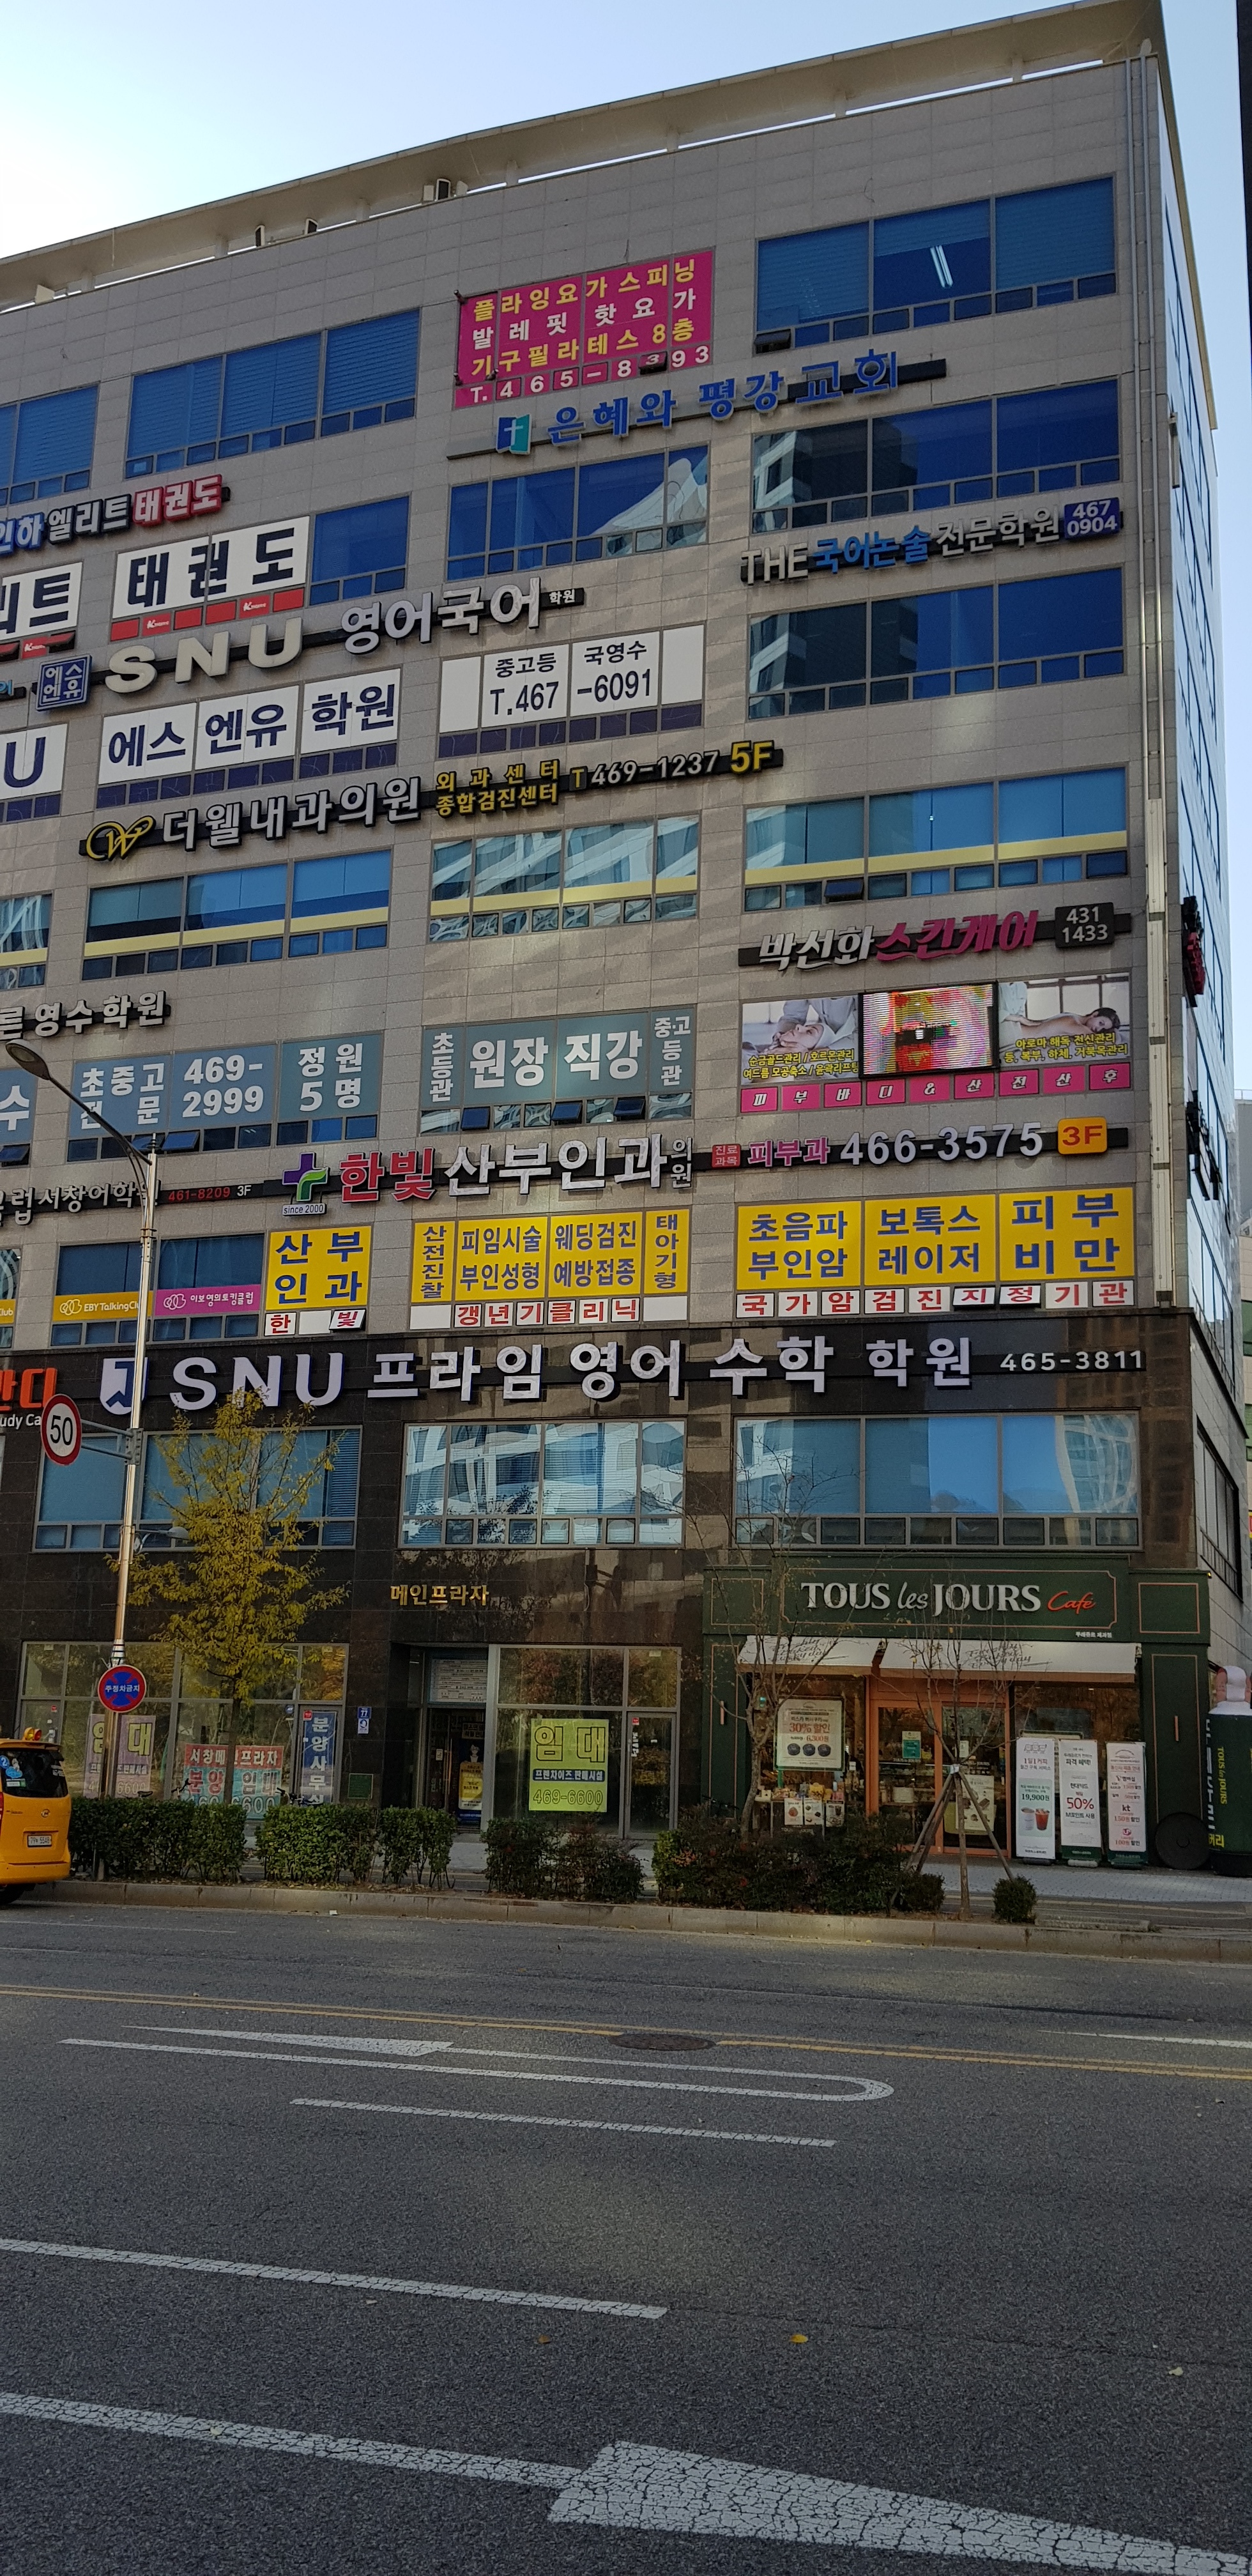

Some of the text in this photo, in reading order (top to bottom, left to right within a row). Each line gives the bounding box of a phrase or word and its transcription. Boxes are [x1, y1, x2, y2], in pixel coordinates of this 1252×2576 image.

[618, 259, 695, 293] 스피닝
[472, 318, 694, 377] 기구필라테스 8층
[547, 390, 677, 446] 은혜와
[1067, 516, 1118, 535] 0904
[1073, 500, 1111, 519] 467
[128, 528, 294, 608] 태권도
[105, 577, 576, 694] SNU 영어국어 학원
[495, 652, 556, 679] 중고등
[584, 641, 647, 666] 국영수
[312, 684, 395, 735] 학원
[592, 750, 719, 786] 469-1237
[731, 740, 774, 773] 5F
[163, 776, 420, 851] 더웰내과의원
[436, 783, 558, 817] 종합검진센터
[1066, 907, 1100, 924] 431
[1062, 925, 1109, 945] 1433
[1016, 1032, 1115, 1050] 아로마 해독 전신관리
[80, 1062, 165, 1098] 초중고
[184, 1054, 263, 1085] 469-
[429, 1032, 454, 1103] 초등관
[743, 1067, 770, 1080] 여드름
[182, 1086, 264, 1118] 2999
[747, 1121, 1103, 1168] 피부과 466-3575 3F
[339, 1133, 692, 1204] 한빛 산부인과 의원
[168, 1188, 230, 1202] 461-8209
[237, 1185, 252, 1197] 3F
[305, 1204, 324, 1213] 2000
[749, 1210, 848, 1243] 초음파
[877, 1205, 981, 1236] 보톡스
[461, 1220, 637, 1255] 피임시술 웨딩검진
[653, 1214, 680, 1289] 태아기형
[420, 1225, 447, 1299] 산전진찰
[460, 1257, 636, 1292] 부인성형 예방접종
[748, 1247, 848, 1281] 부인암
[878, 1243, 980, 1275] 레이저
[84, 1303, 100, 1312] EBY
[170, 1335, 1143, 1410] SNU 프라임 영어 수학 학원 465-3811
[50, 1414, 73, 1446] 50
[390, 1584, 491, 1607] 메인프라자
[801, 1582, 890, 1610] TOUS
[897, 1581, 929, 1610] les
[933, 1584, 1041, 1617] JOURS
[105, 1684, 140, 1692] 주정차금지
[789, 1722, 812, 1733] 30%
[534, 1726, 606, 1763] 임대
[533, 1789, 603, 1805] 469-6600
[1021, 1793, 1050, 1802] 19,900원
[1066, 1797, 1094, 1809] 50%
